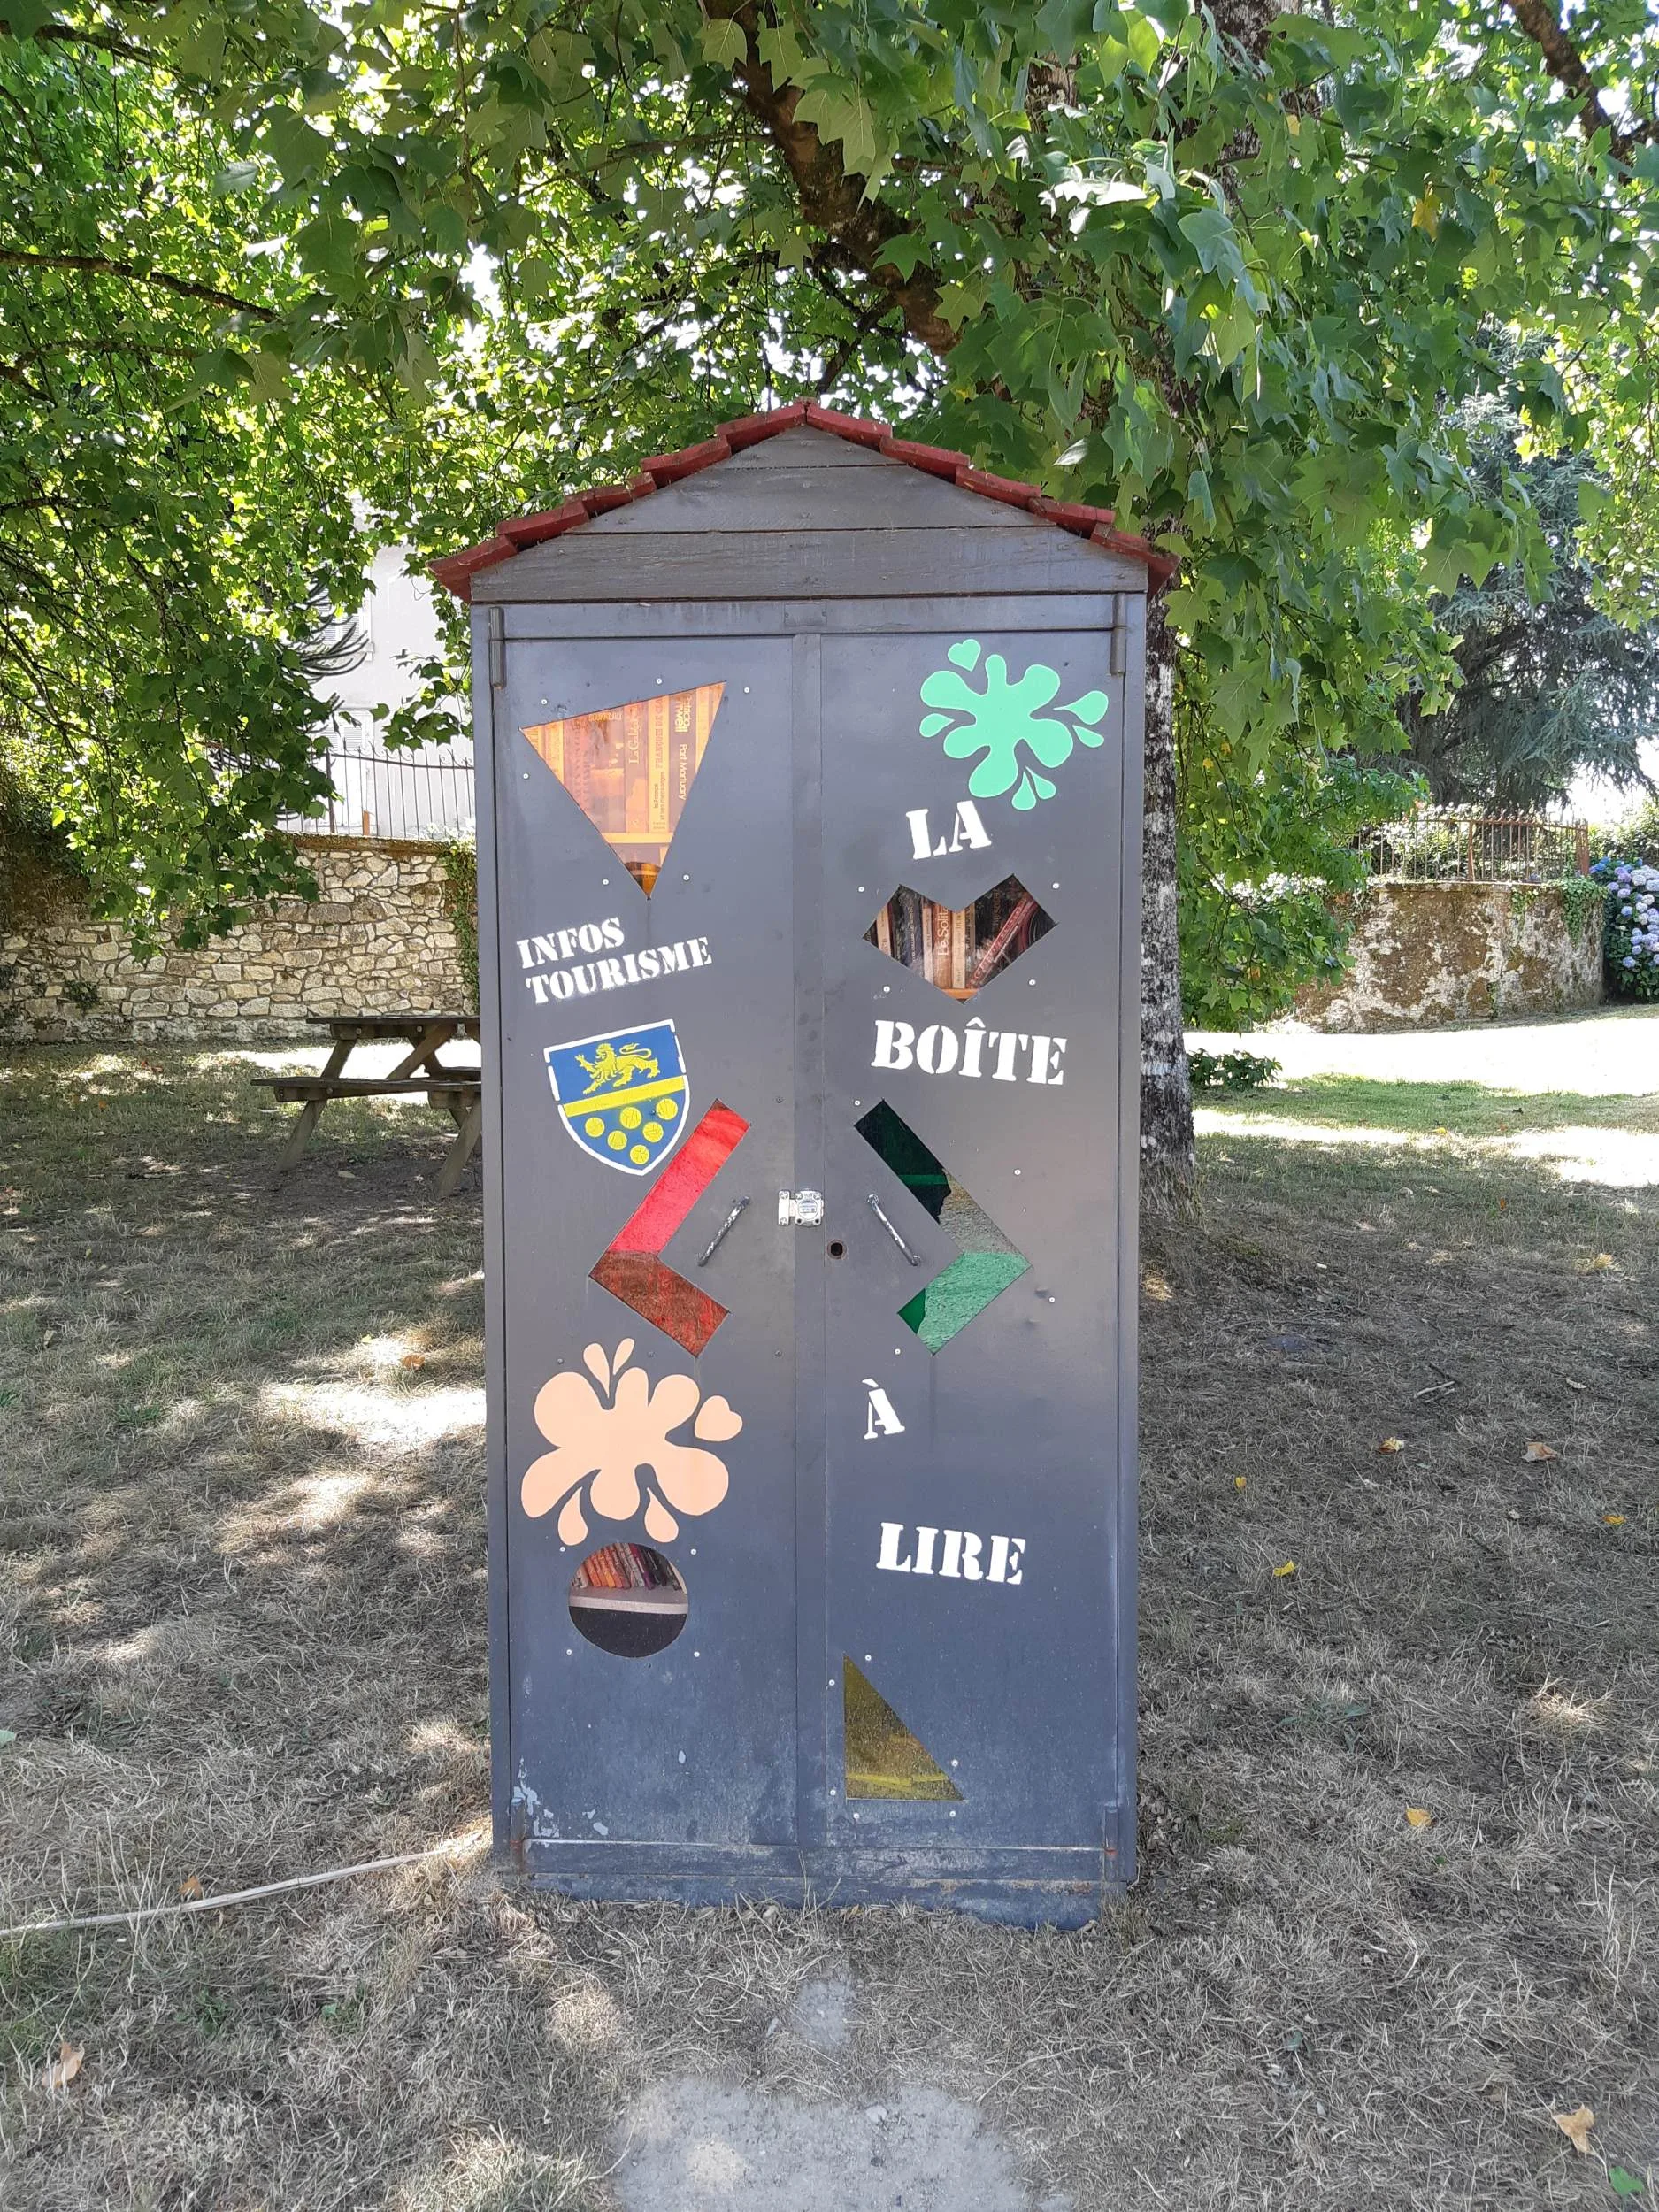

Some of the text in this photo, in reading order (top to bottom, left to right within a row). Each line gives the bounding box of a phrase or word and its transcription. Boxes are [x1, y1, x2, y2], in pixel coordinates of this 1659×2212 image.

[679, 743, 688, 801] Port Mortuary
[906, 800, 992, 859] LA
[517, 917, 625, 969] INFOS
[526, 936, 712, 1004] TOURISME
[871, 1016, 1067, 1086] BOÎTE
[862, 1378, 905, 1440] À
[876, 1522, 1026, 1585] LIRE
